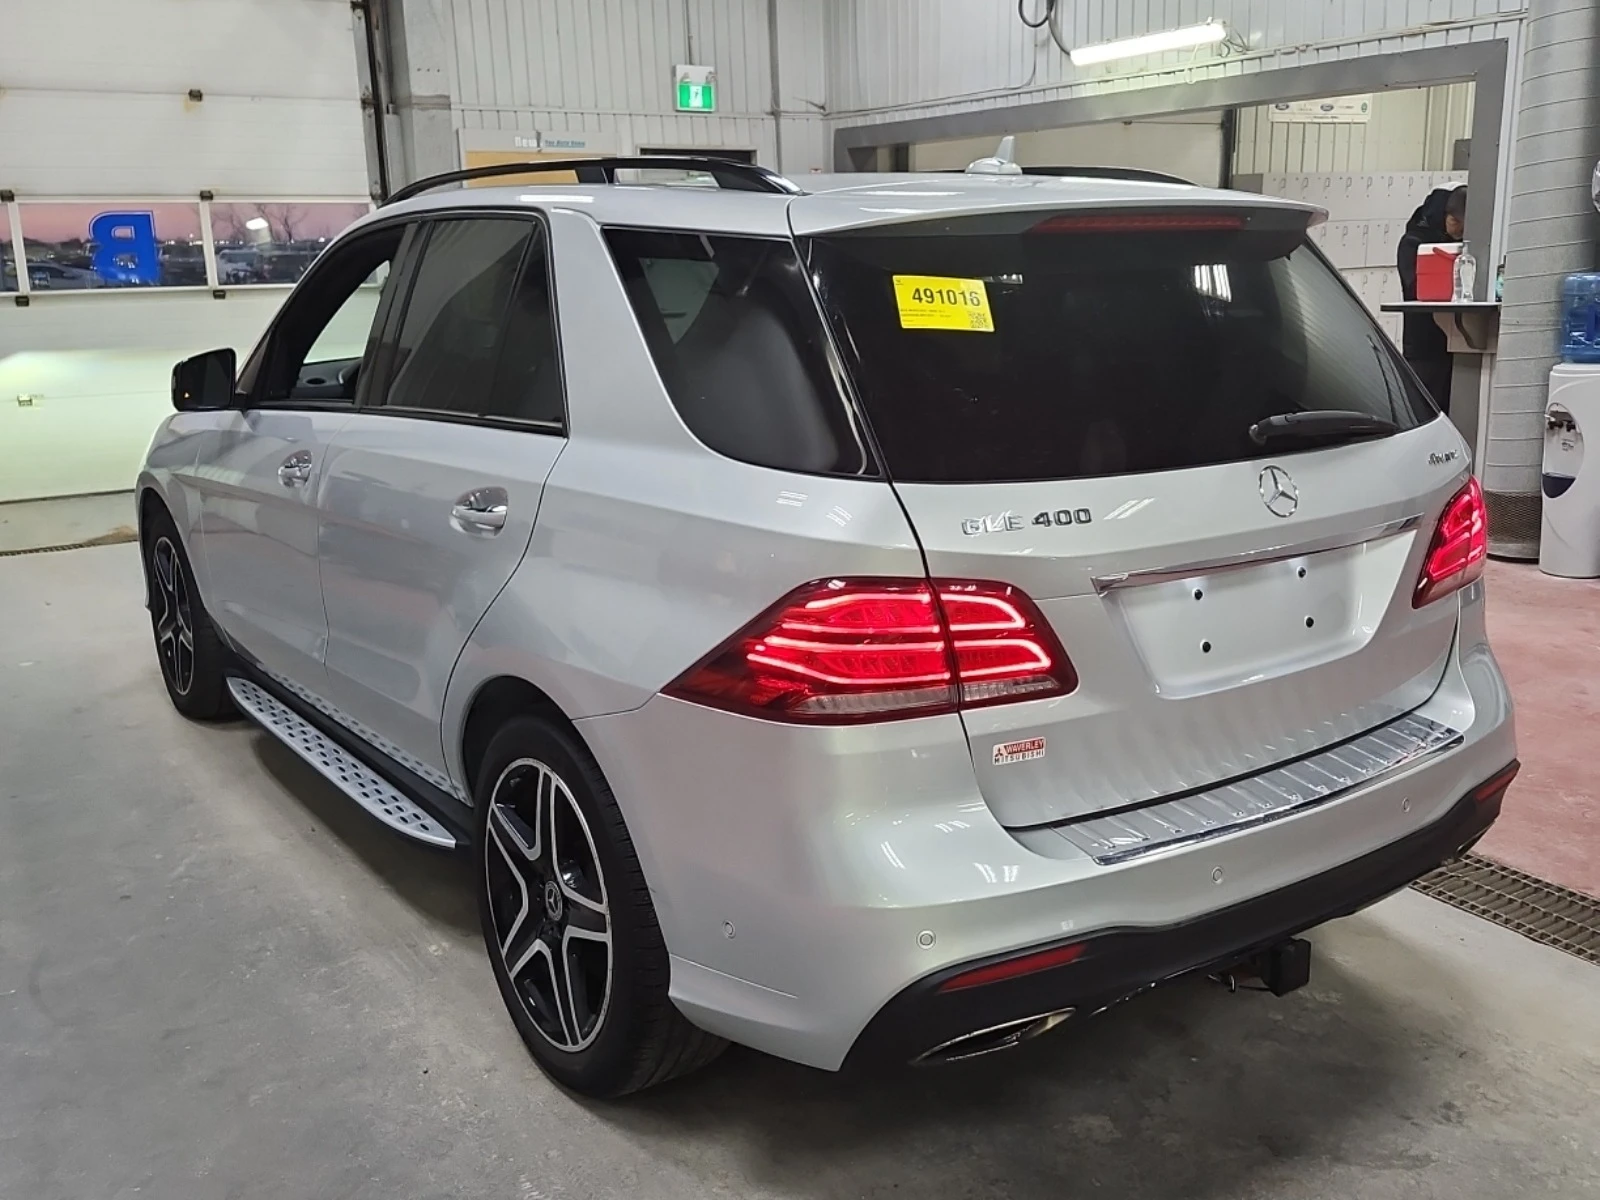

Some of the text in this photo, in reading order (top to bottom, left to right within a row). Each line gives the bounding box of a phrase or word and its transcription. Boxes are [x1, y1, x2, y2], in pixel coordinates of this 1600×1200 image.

[911, 287, 981, 307] 491016
[961, 507, 1093, 536] GLE 400
[1006, 739, 1044, 754] WAVERLEY
[994, 750, 1045, 765] MITSUBISHI
